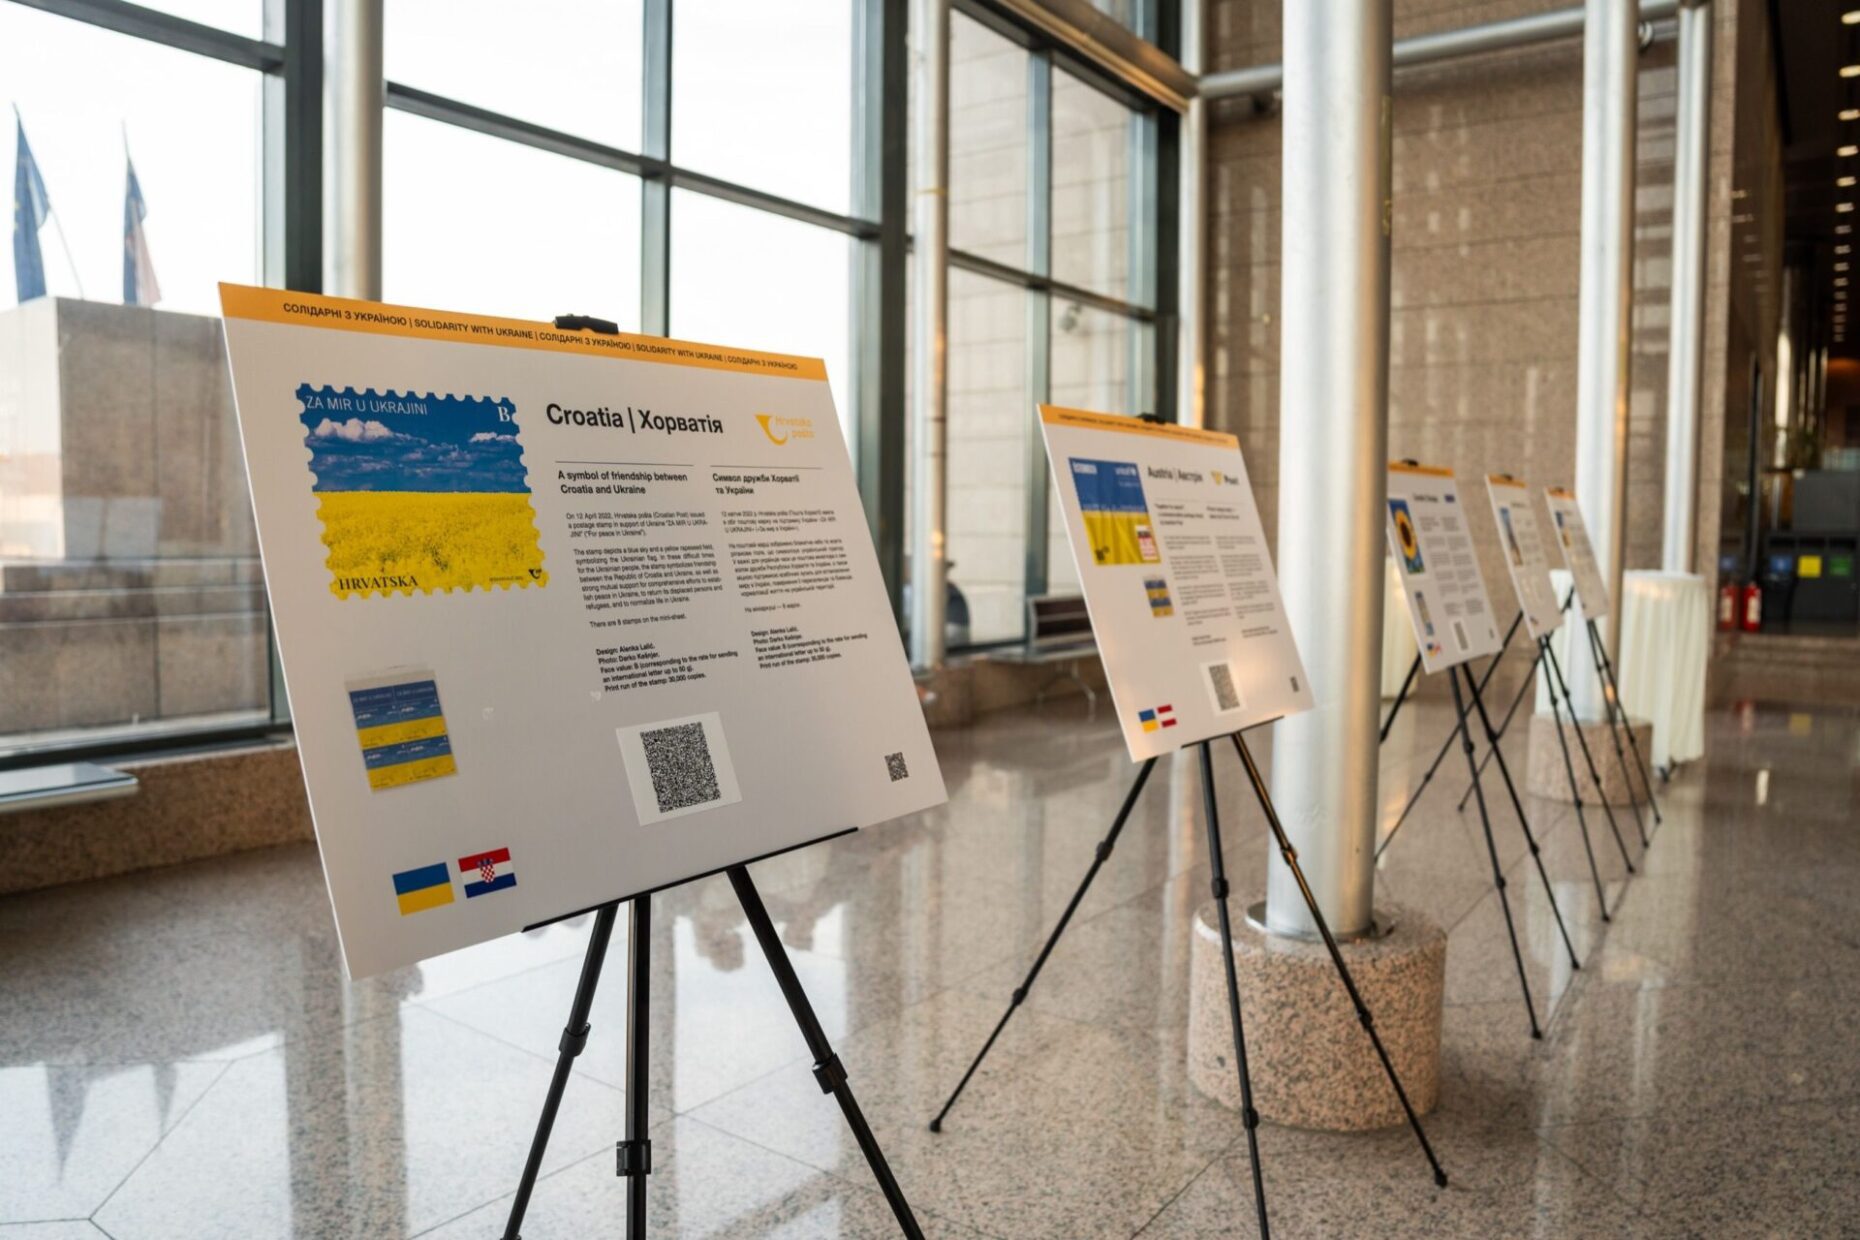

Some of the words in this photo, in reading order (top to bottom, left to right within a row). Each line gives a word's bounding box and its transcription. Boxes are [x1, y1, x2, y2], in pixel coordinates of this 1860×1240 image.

[283, 302, 342, 318] СОЛІДАРНІ
[344, 310, 351, 319] З
[354, 312, 406, 326] УКРАЇНОЮ
[414, 318, 467, 331] SOLIDARITY
[470, 325, 493, 334] WITH
[495, 328, 532, 338] UKRAINE
[539, 332, 582, 343] СОЛІДАРНІ
[592, 338, 631, 350] УКРАЇНОЮ
[306, 396, 324, 409] ZA
[328, 398, 352, 411] MIR
[357, 400, 366, 412] U
[370, 401, 428, 415] UKRAJINI
[498, 406, 510, 422] B
[546, 403, 623, 428] Croatia
[638, 409, 723, 434] Хорватія
[558, 470, 565, 479] A
[566, 470, 598, 481] symbol
[600, 470, 609, 479] of
[611, 471, 652, 481] friendship
[653, 472, 687, 480] between
[561, 484, 593, 493] Croatia
[595, 485, 611, 493] and
[613, 484, 645, 493] Ukraine
[339, 576, 418, 590] HRVATSKA
